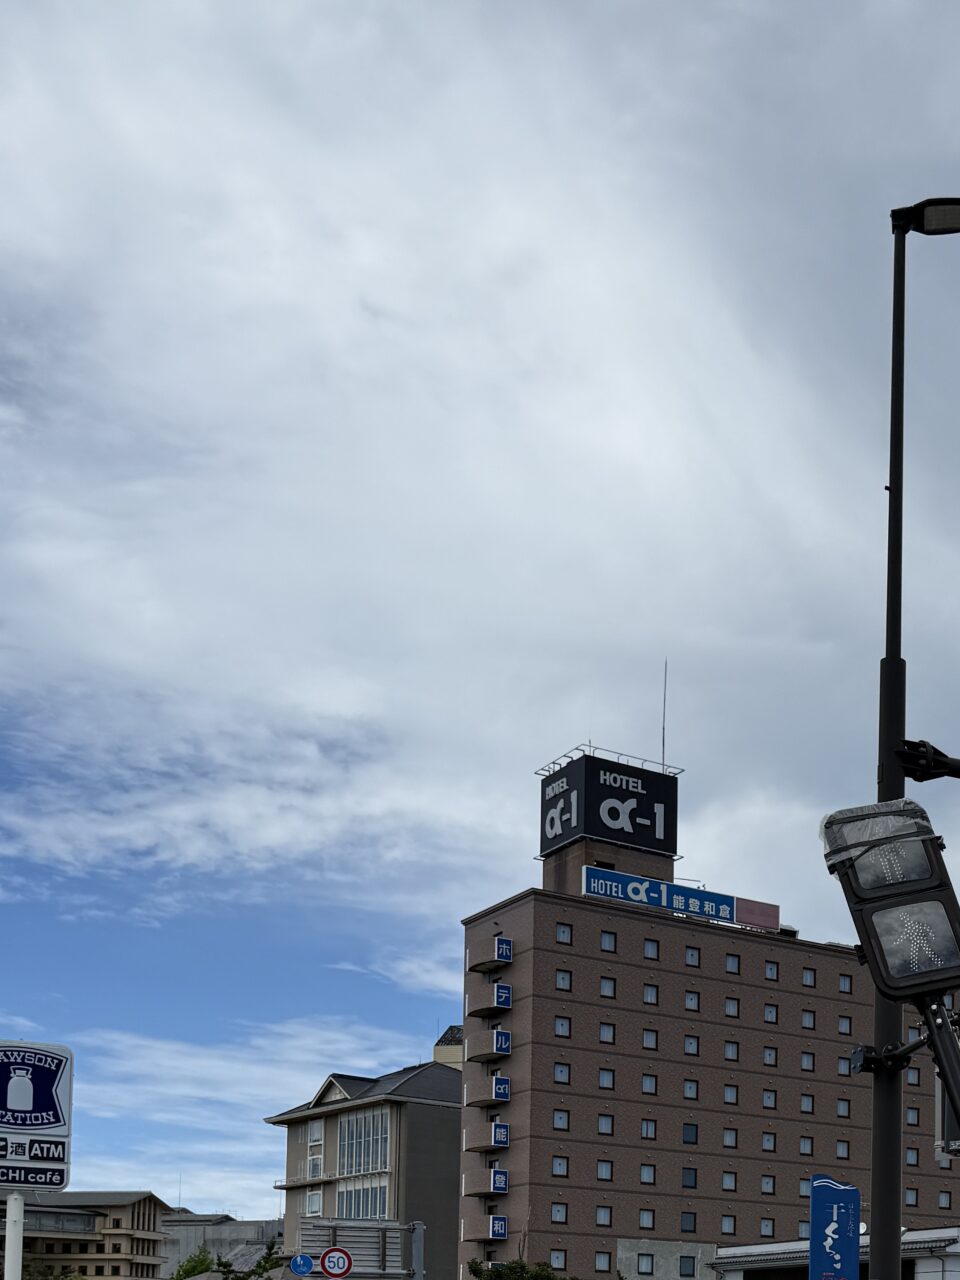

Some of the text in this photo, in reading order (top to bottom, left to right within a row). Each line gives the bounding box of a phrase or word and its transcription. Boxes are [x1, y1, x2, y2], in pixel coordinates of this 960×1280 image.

[545, 777, 569, 800] HOTEL
[600, 770, 647, 794] HOTEL
[591, 878, 623, 897] HOTEL
[672, 894, 731, 918] 能登和倉
[10, 1142, 27, 1156] 酒
[30, 1143, 64, 1159] ATM
[27, 1171, 62, 1184] café
[327, 1256, 346, 1270] 50
